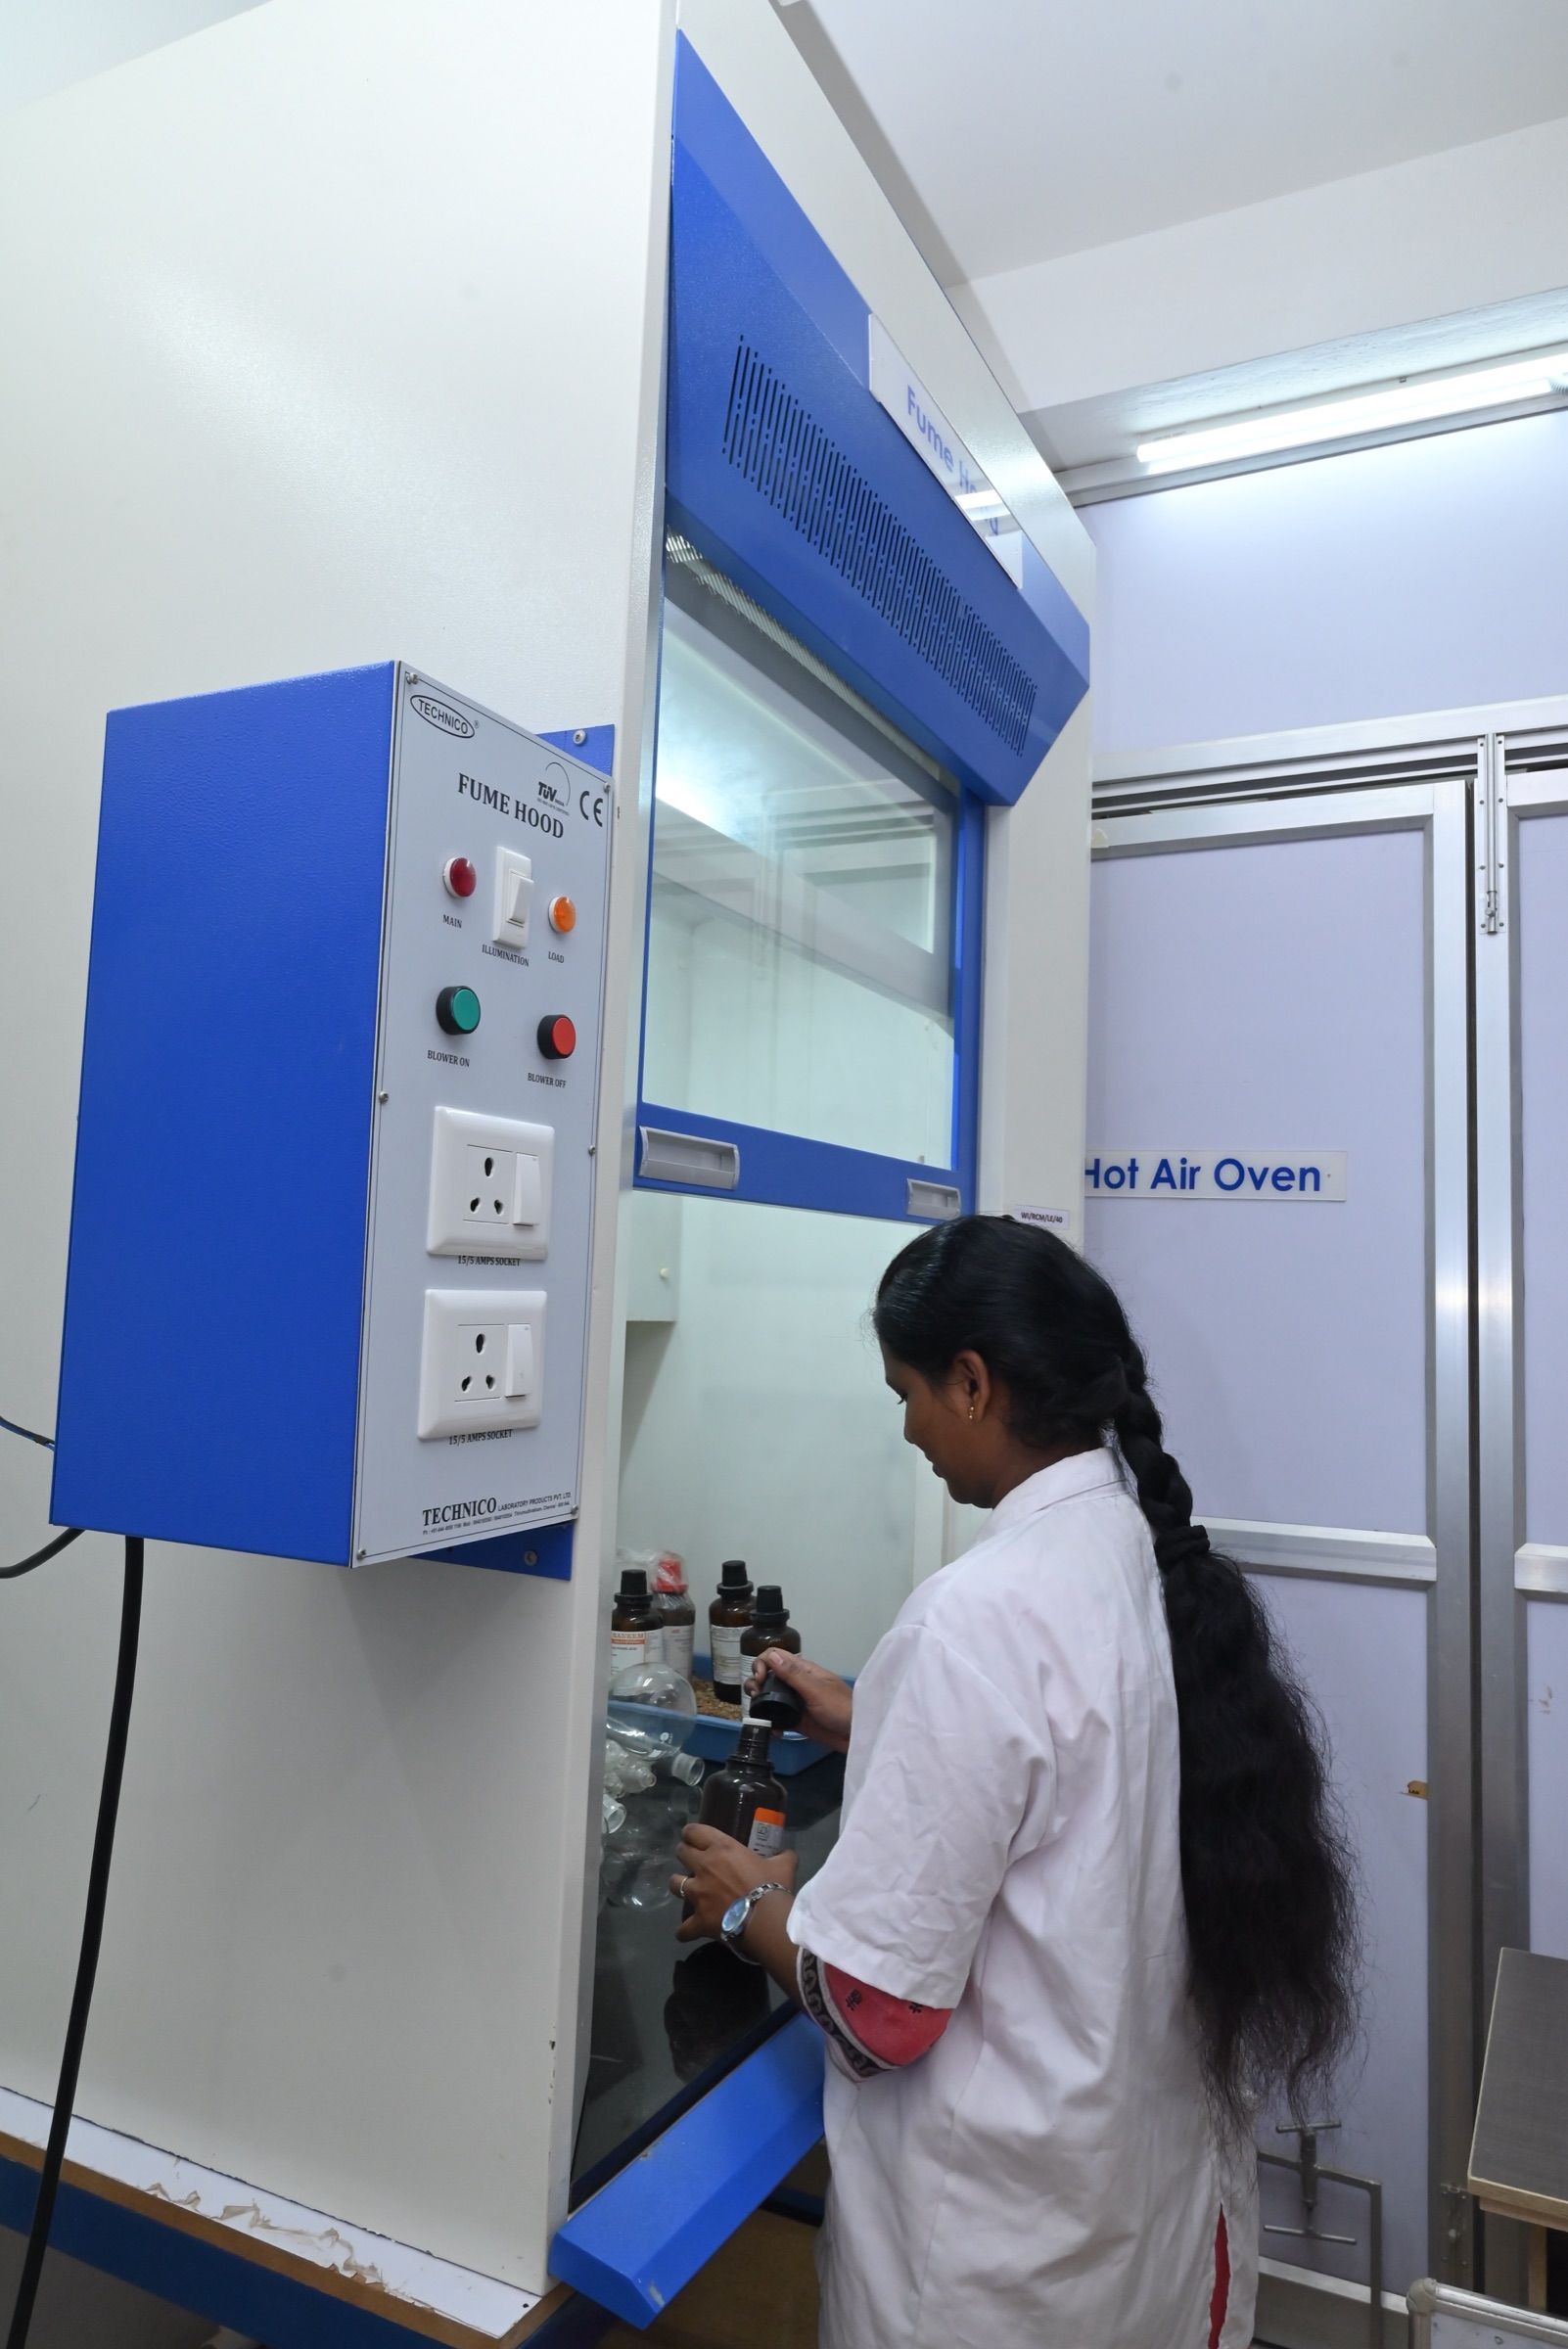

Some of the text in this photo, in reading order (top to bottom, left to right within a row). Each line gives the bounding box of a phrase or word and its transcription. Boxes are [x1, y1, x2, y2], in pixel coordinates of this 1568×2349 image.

[906, 385, 954, 474] Fume
[418, 698, 469, 735] TECHNICO
[457, 772, 510, 815] FUME
[514, 800, 565, 839] HOOD
[579, 790, 604, 828] CE
[442, 914, 463, 929] MAIN
[482, 944, 530, 967] ILLUMINATION
[547, 950, 565, 964] LOAD
[427, 1049, 471, 1068] BLOWER ON
[528, 1072, 567, 1088] BLOWER OFF
[1150, 1157, 1201, 1190] Air
[1214, 1158, 1320, 1192] Oven
[458, 1255, 521, 1267] 15/5 AMPS SOCKET
[448, 1429, 513, 1447] 15/5 AMPS SOCKET
[422, 1497, 497, 1526] TECHNICO
[498, 1499, 529, 1511] LABORATORY
[529, 1495, 553, 1505] PRODUCTS
